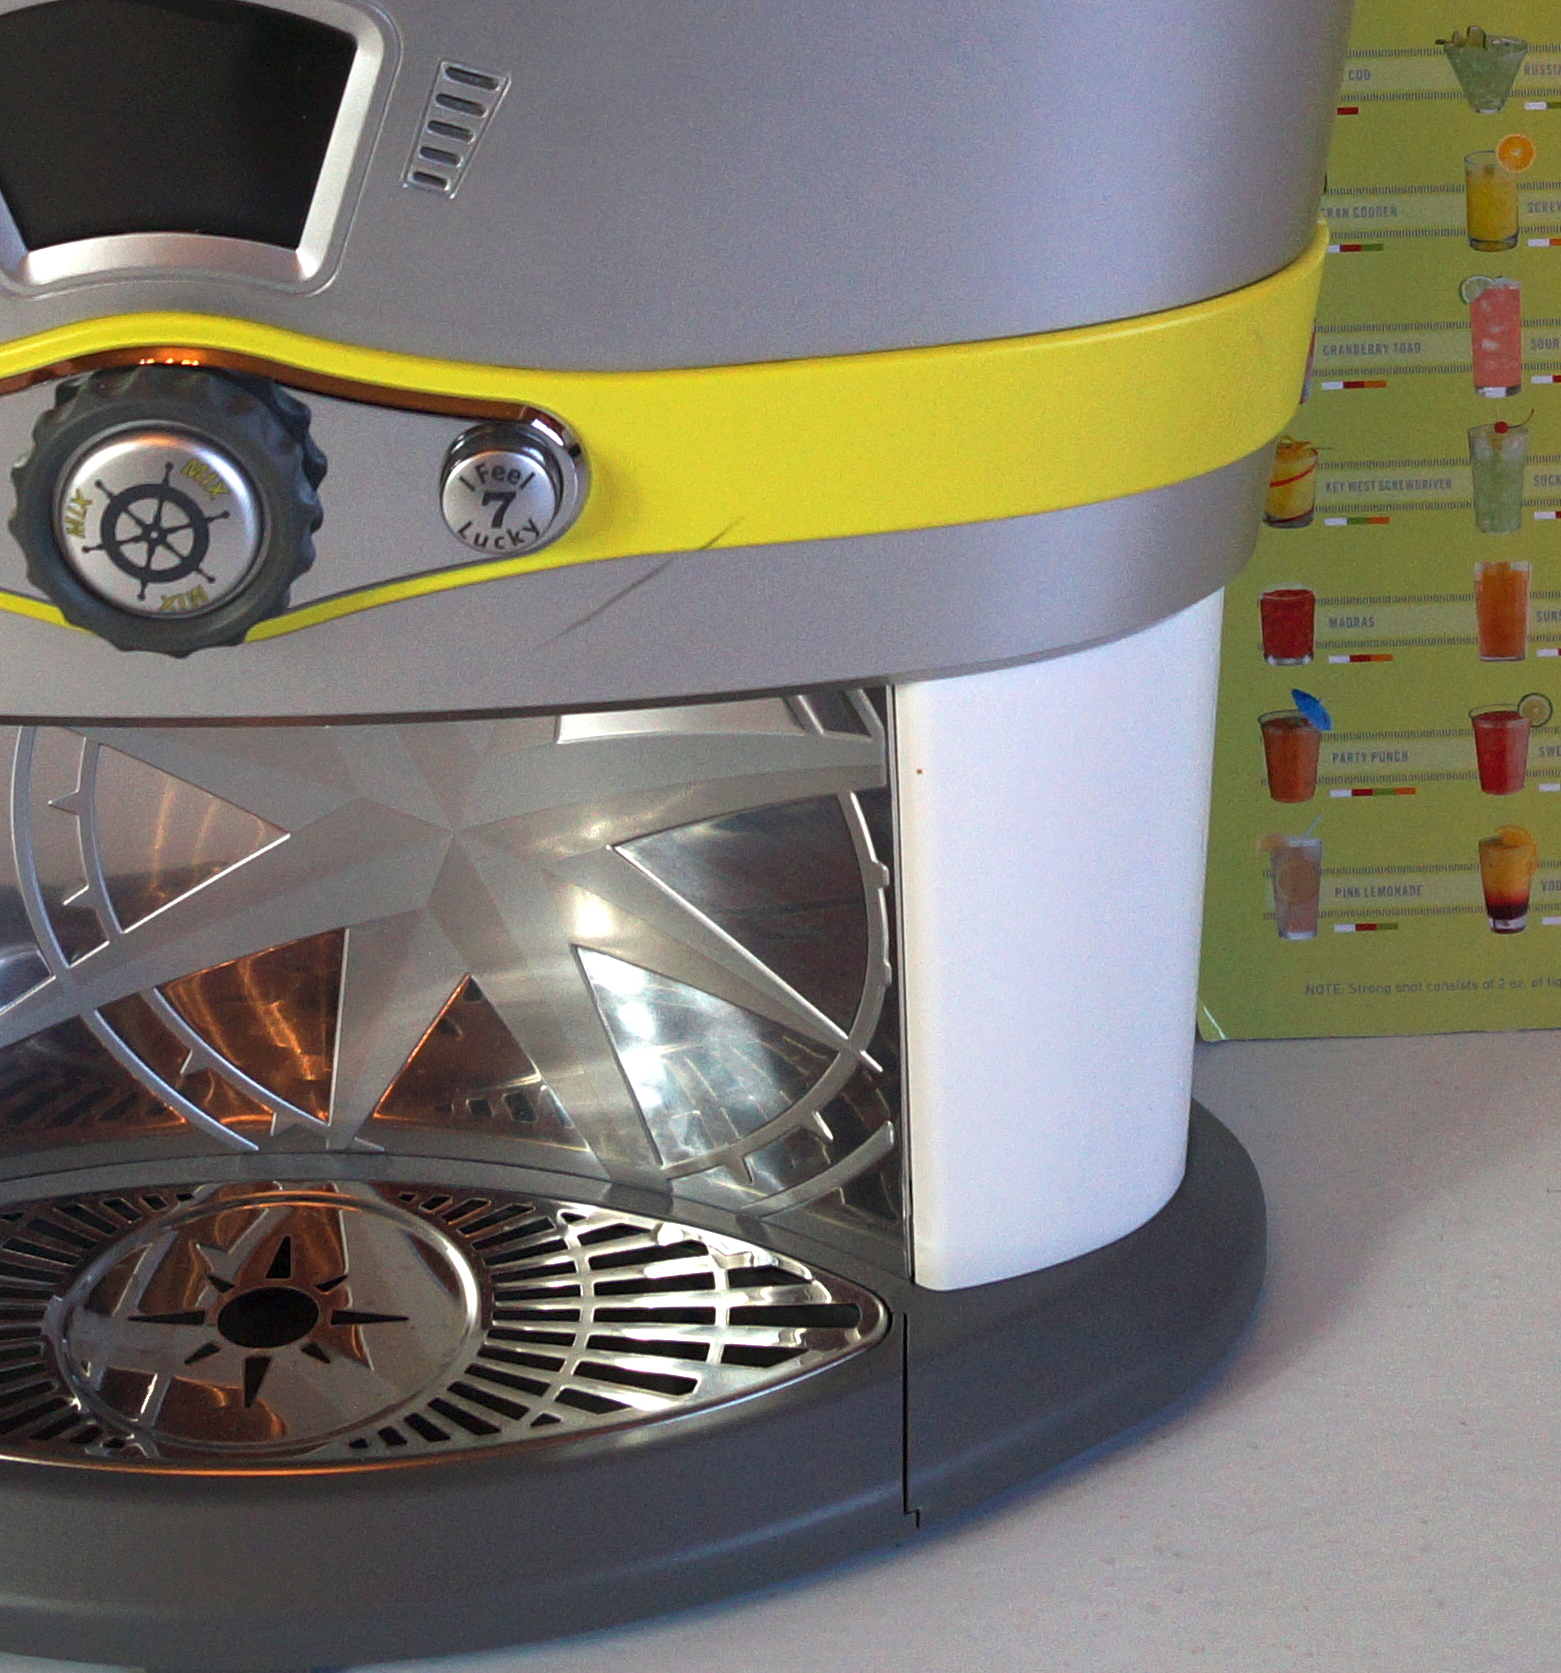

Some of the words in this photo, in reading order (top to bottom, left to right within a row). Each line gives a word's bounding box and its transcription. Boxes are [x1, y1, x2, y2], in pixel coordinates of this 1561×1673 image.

[1322, 342, 1388, 356] CRANBERRY
[1530, 338, 1559, 350] SOUR
[180, 458, 231, 501] MIX
[458, 475, 475, 493] I
[475, 463, 535, 490] Feel
[1325, 481, 1348, 493] KEY
[1350, 480, 1375, 492] WEST
[1378, 478, 1452, 491] SCREWDRIVER
[65, 488, 92, 539] MIX
[482, 491, 517, 529] 7
[457, 519, 540, 549] Lucky
[159, 586, 209, 613] MIX
[1328, 616, 1375, 628] MADRAS
[1332, 752, 1368, 764] PARTY
[1370, 751, 1409, 763] PUNCH
[1335, 887, 1361, 898] PINK
[1364, 885, 1423, 898] LEMONADE
